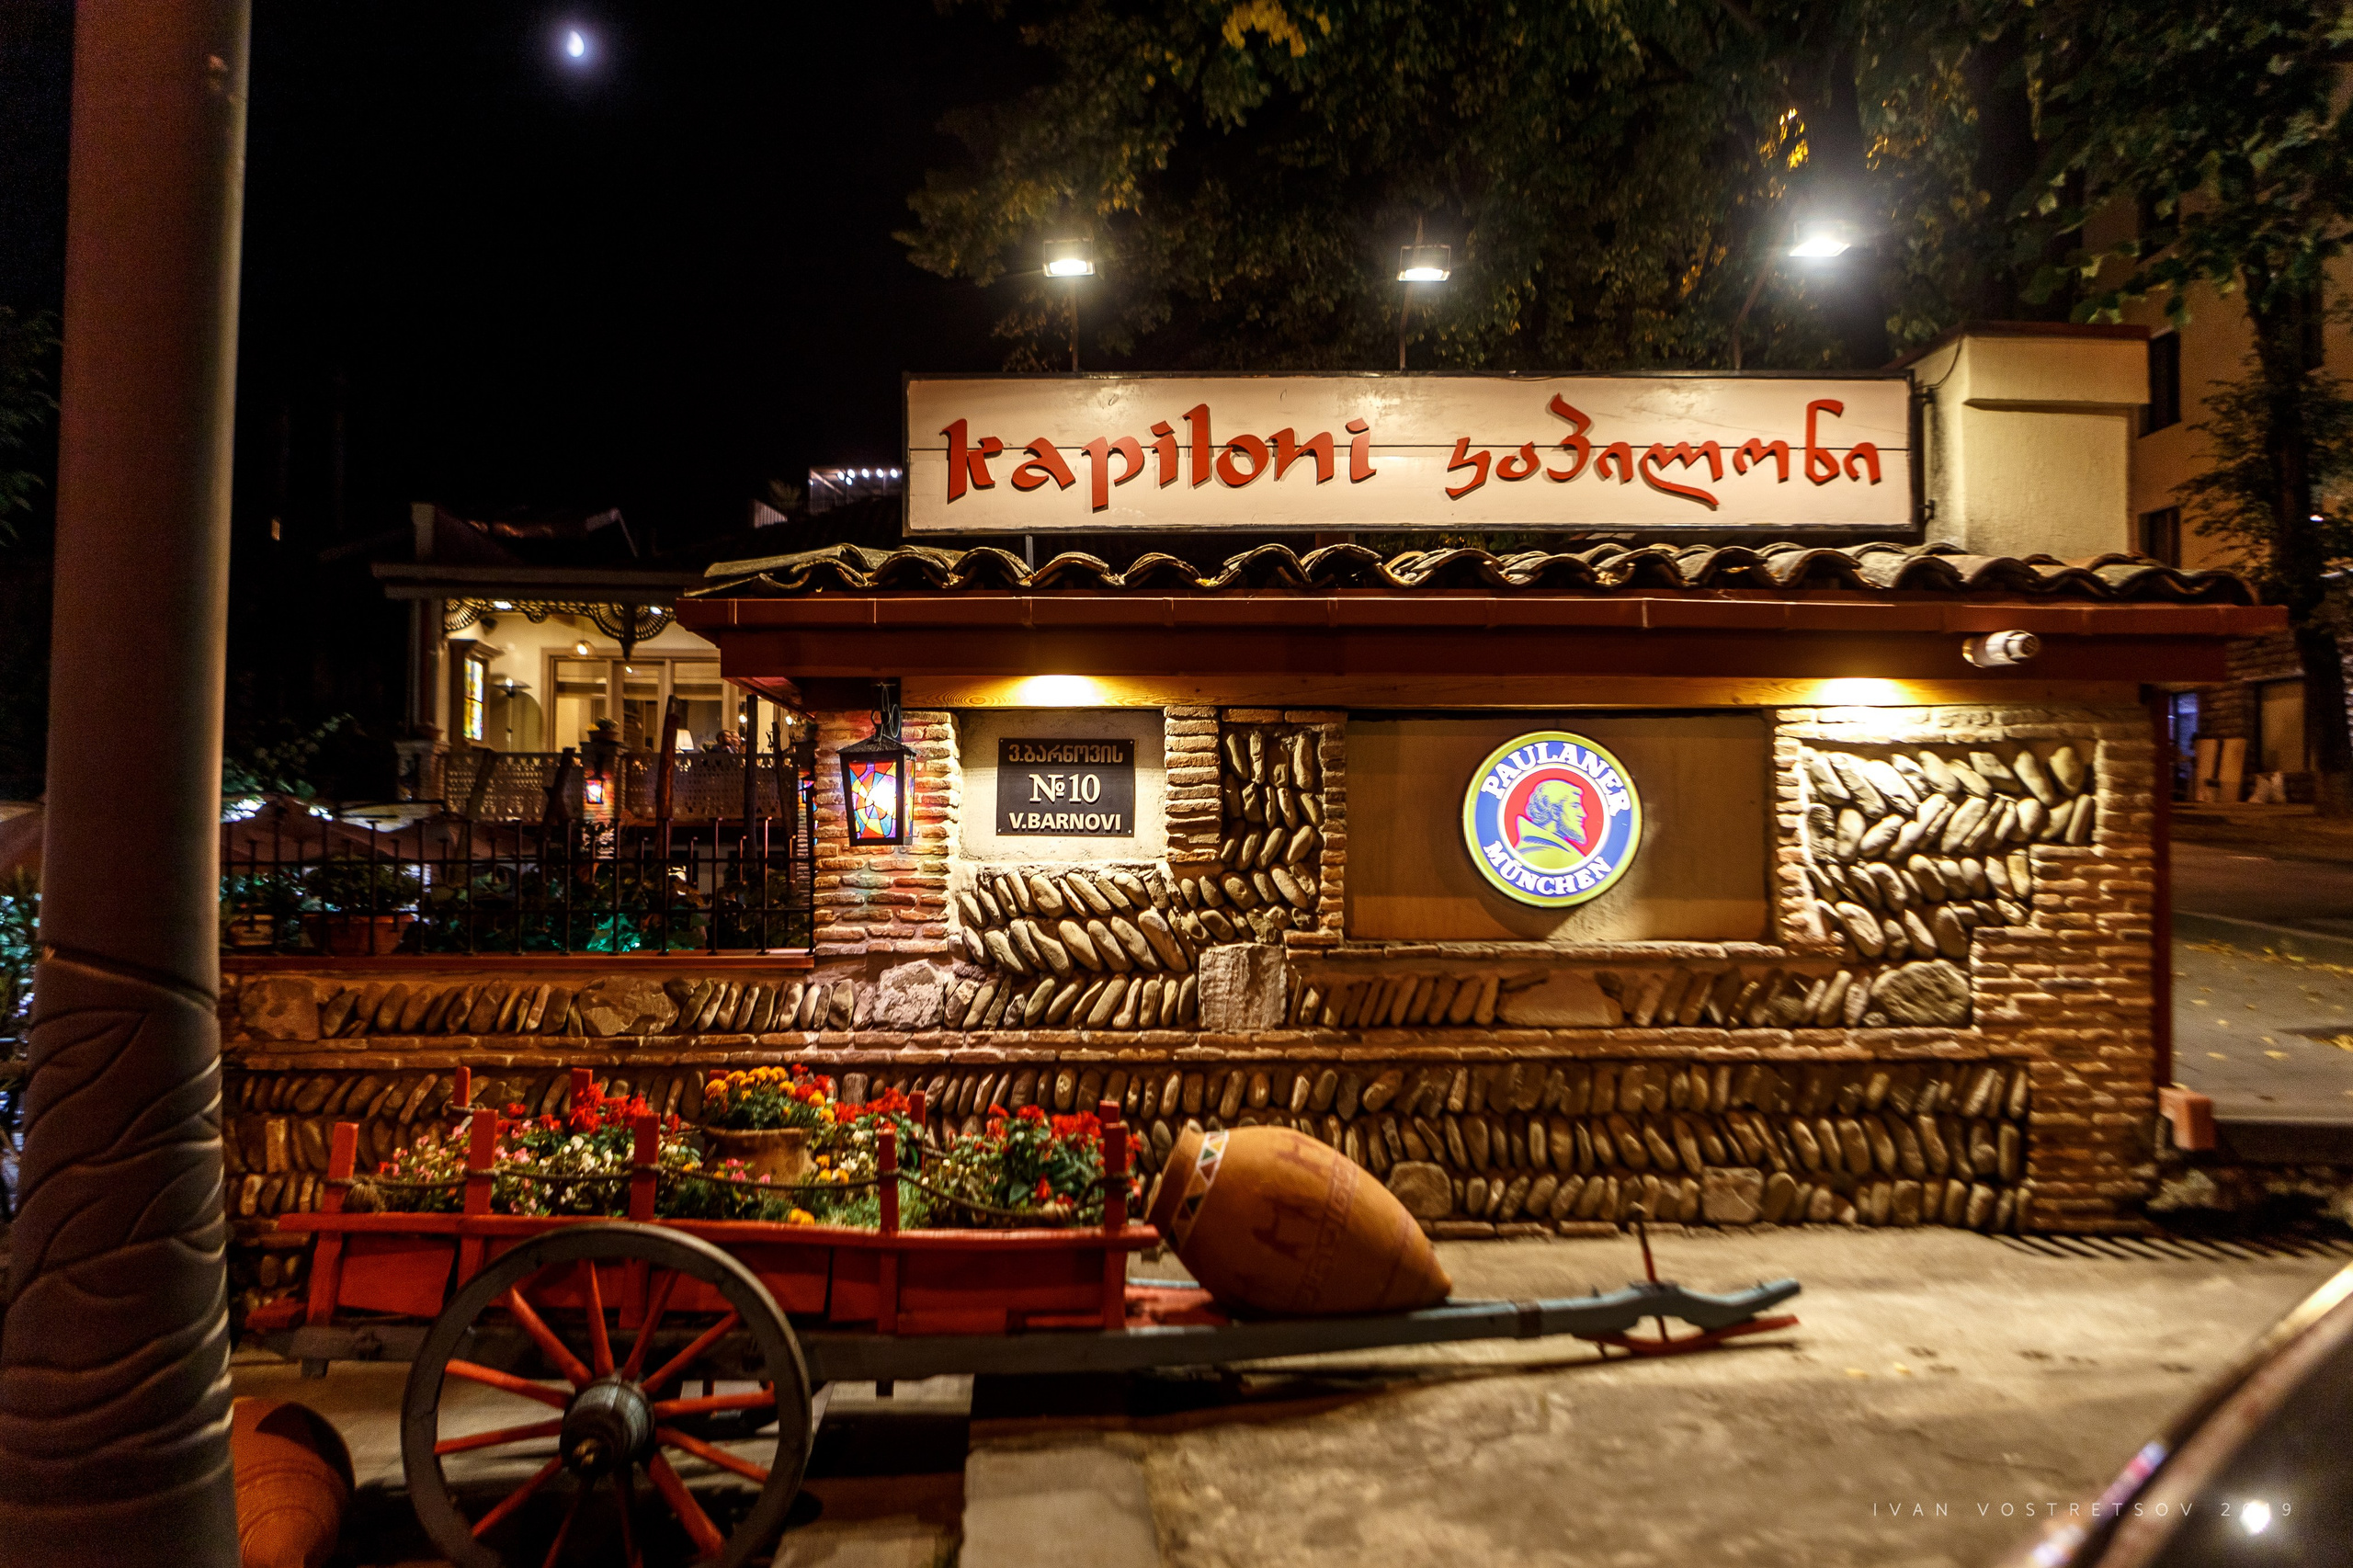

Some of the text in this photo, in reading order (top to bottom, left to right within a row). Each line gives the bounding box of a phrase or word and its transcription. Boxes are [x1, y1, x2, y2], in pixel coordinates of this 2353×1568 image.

[939, 403, 1377, 510] kapiloni
[1480, 742, 1631, 817] PAULANER
[1008, 812, 1121, 831] V.BARNOVI
[1483, 839, 1613, 896] MÜNCHEN
